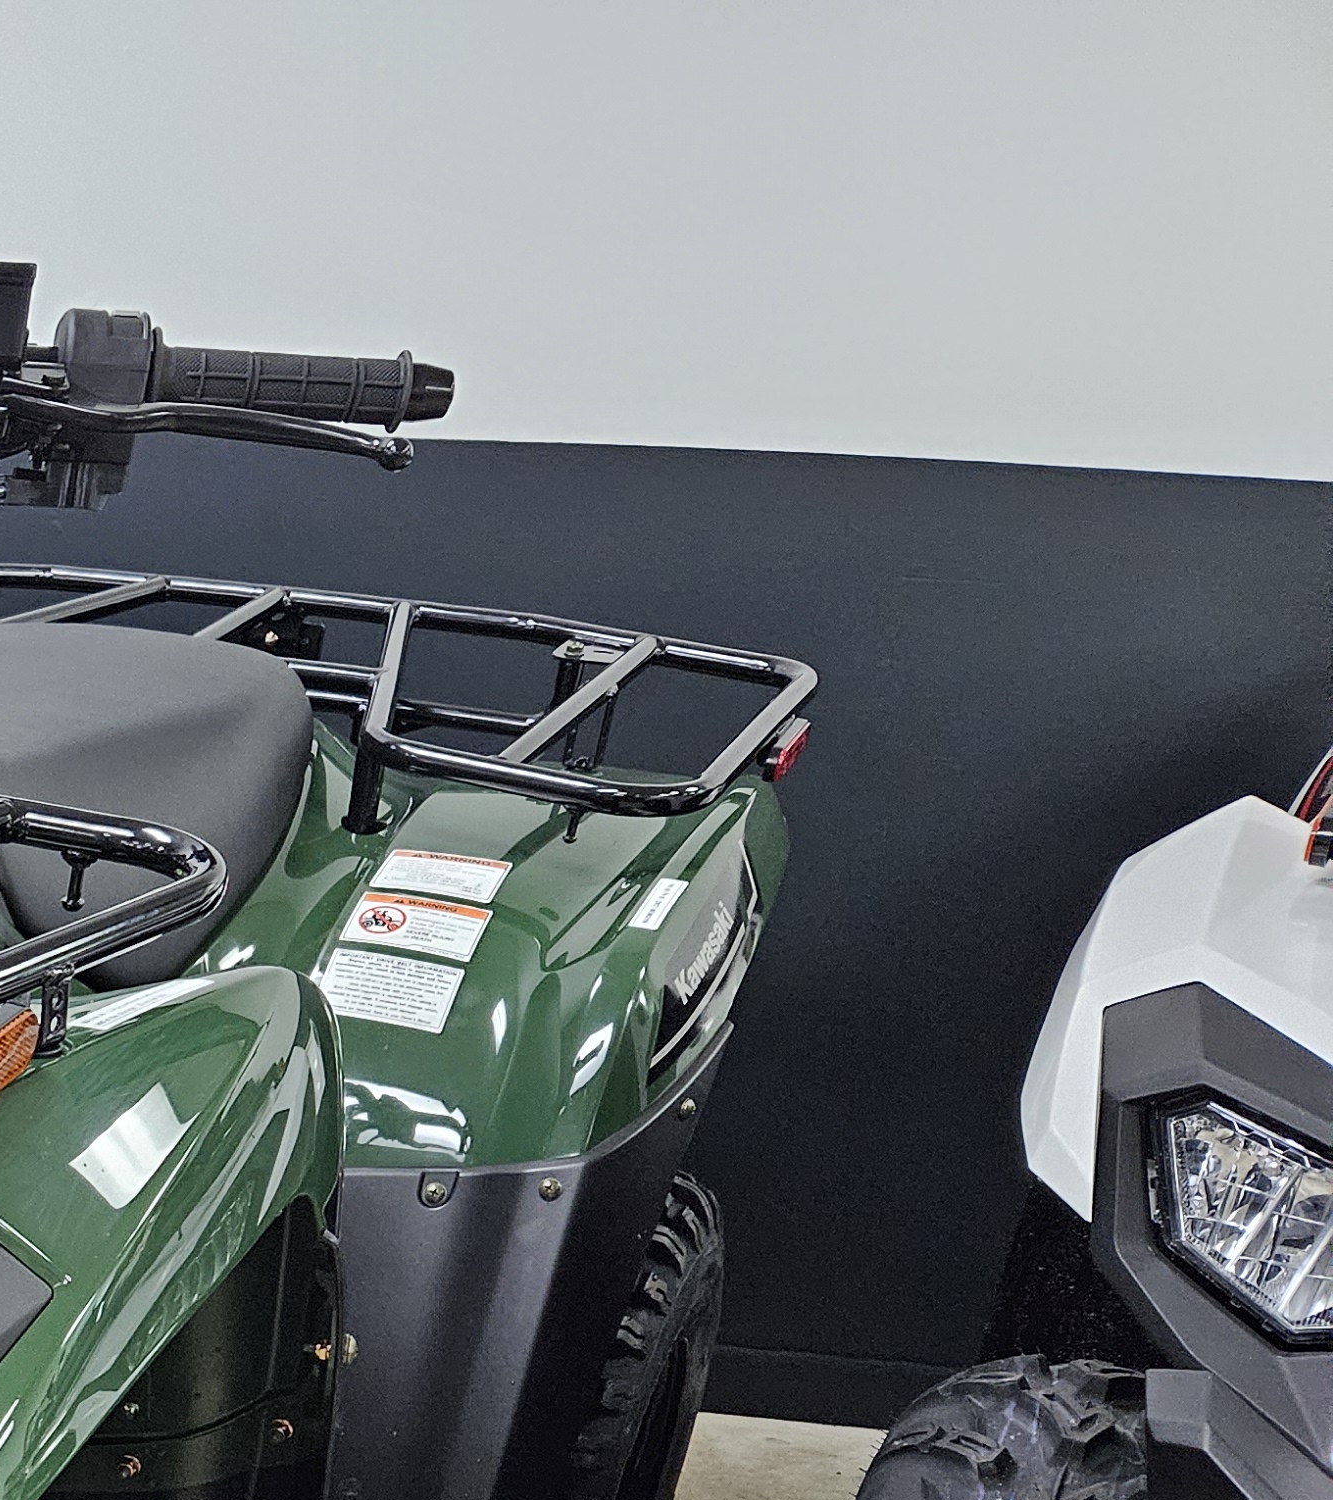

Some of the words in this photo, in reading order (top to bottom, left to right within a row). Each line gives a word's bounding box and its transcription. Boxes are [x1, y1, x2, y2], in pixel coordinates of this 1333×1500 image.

[428, 853, 492, 866] WARNING
[406, 899, 459, 913] WARNING
[673, 900, 734, 1006] Kawasaki
